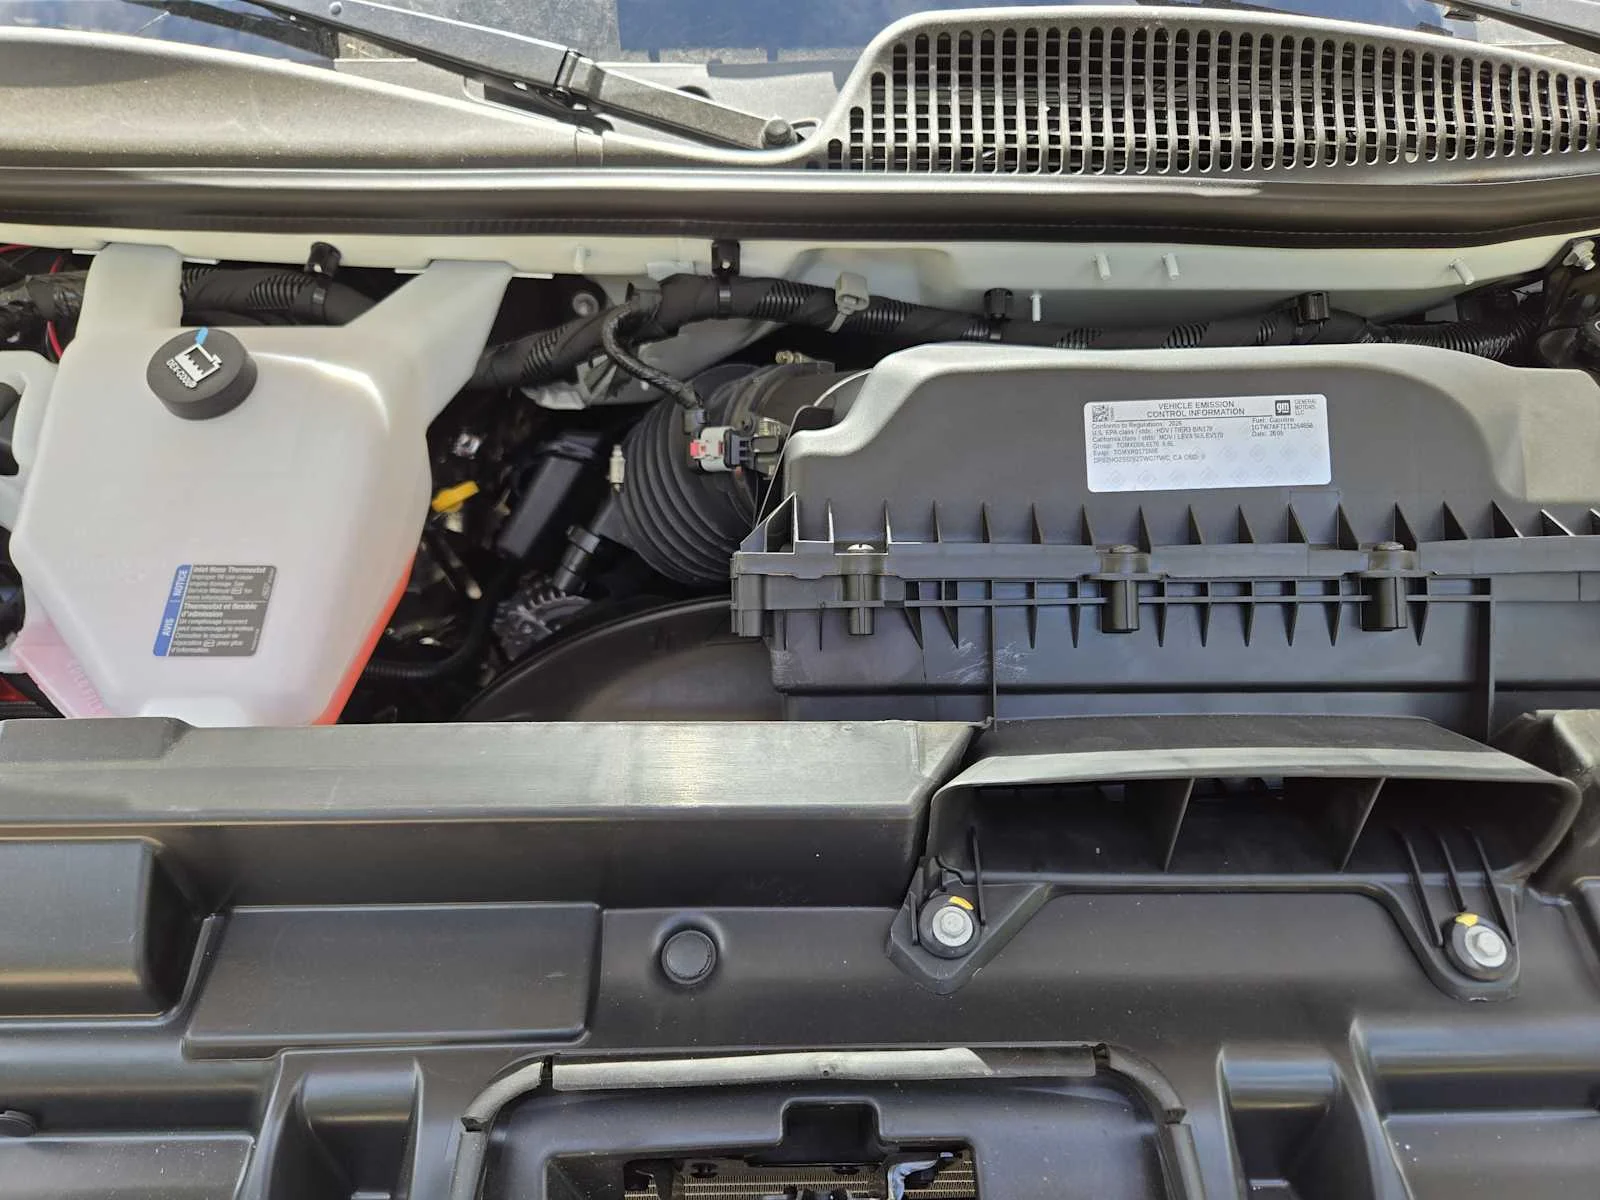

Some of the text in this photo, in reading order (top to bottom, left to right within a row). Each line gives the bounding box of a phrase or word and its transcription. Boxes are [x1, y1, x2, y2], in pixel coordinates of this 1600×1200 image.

[1158, 400, 1235, 410] VEHICLE EMISSION
[1146, 408, 1245, 418] CONTROL INFORMATION
[172, 569, 188, 596] NOTICE
[162, 618, 175, 637] AVIS
